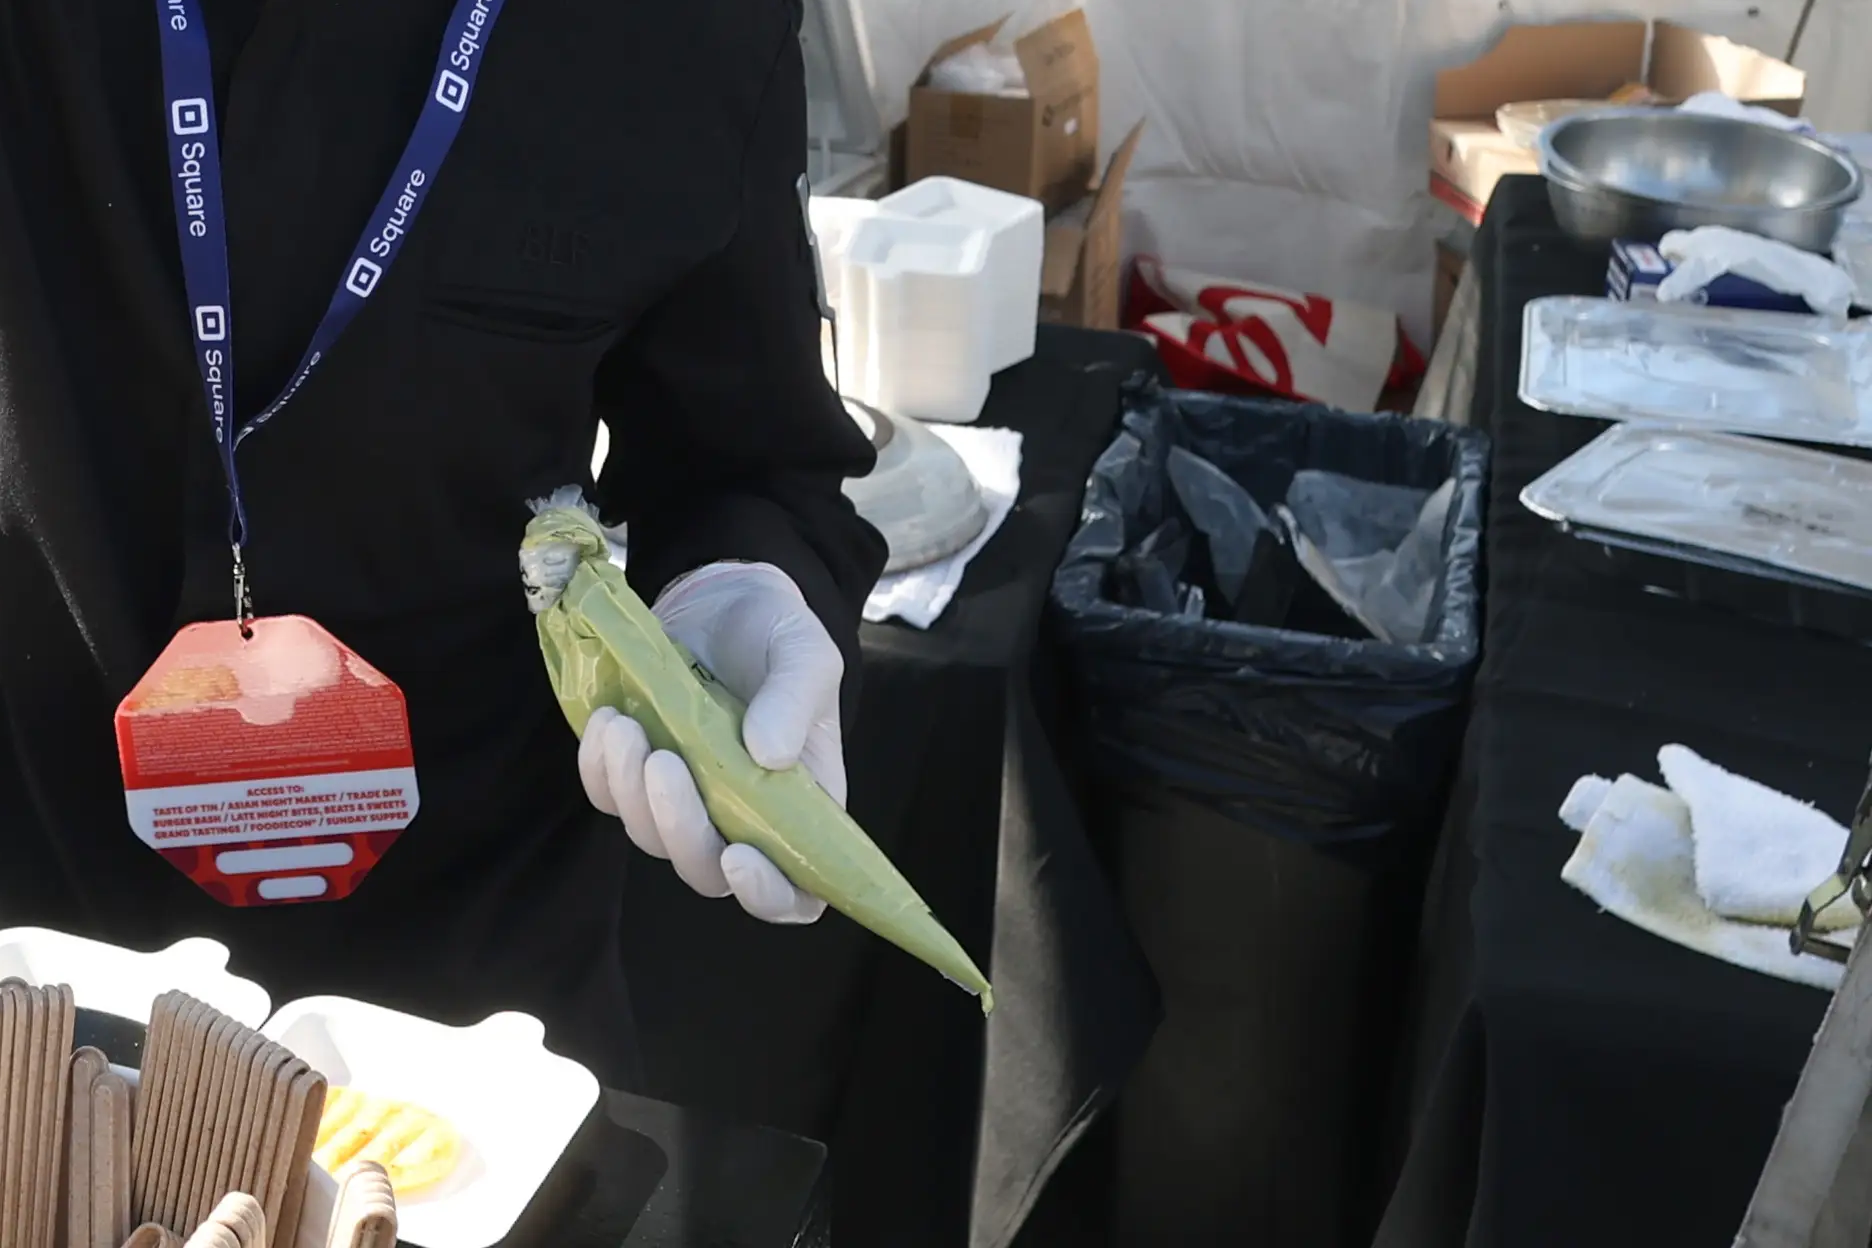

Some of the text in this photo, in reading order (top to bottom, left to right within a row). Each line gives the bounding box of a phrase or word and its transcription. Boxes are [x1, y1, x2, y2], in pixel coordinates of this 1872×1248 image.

[178, 141, 207, 238] Square
[370, 168, 426, 258] Square
[205, 349, 224, 444] Square
[152, 806, 184, 816] TASTE
[185, 805, 198, 813] OF
[227, 799, 260, 810] ASIAN
[261, 796, 294, 808] NIGHT
[295, 793, 337, 805] MARKET
[346, 790, 381, 800] TRADE
[382, 788, 404, 797] DAY
[246, 784, 305, 797] ACCESS TO:
[152, 817, 192, 828] BURGER
[194, 815, 222, 825] BASH
[231, 811, 256, 821] LATE
[257, 809, 289, 819] NIGHT
[290, 806, 322, 817] BITES,
[324, 803, 356, 814] BEATS
[357, 802, 365, 811] &
[367, 799, 408, 810] SWEETS
[154, 829, 191, 839] GRAND
[192, 825, 241, 837] TASTINGS
[326, 814, 368, 825] SUNDAY
[370, 810, 409, 821] SUPPER
